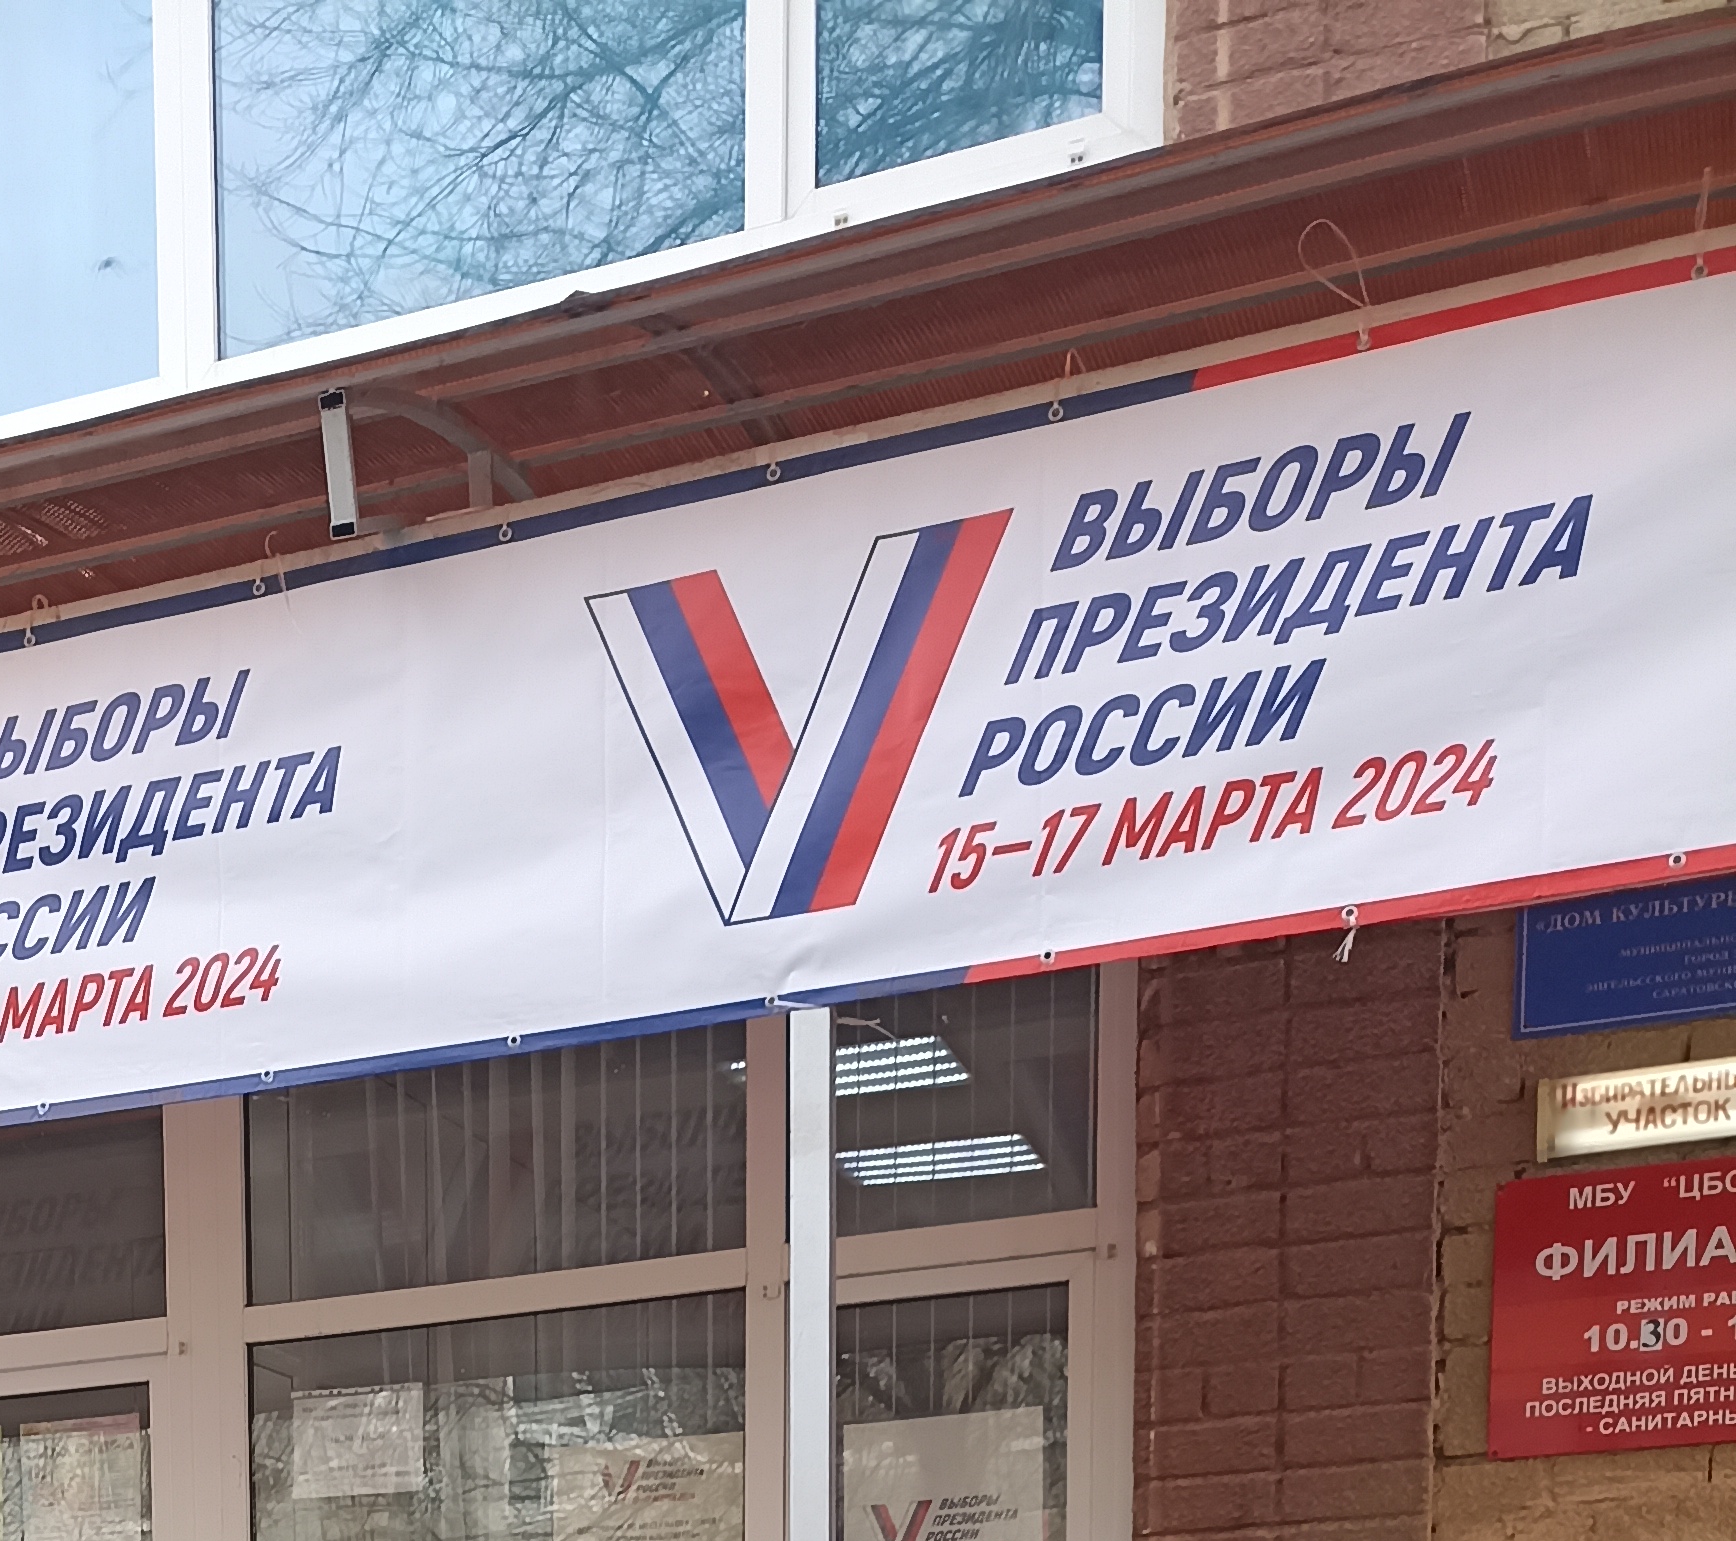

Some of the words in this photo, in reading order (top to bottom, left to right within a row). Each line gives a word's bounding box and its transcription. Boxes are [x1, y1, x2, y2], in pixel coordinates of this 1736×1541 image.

[1050, 412, 1472, 573] ВЫБОРЫ
[1004, 494, 1595, 686] ПРЕЗИДЕНТА
[958, 659, 1327, 798] РОССИИ
[1112, 767, 1324, 869] МАРТА
[1331, 739, 1497, 830] 2024
[1536, 909, 1601, 933] «ДОМ
[163, 944, 280, 1016] 2024
[1605, 1097, 1731, 1134] УЧАСТОК
[1569, 1181, 1635, 1210] МБУ
[1535, 1226, 1736, 1281] ФИЛИА
[1616, 1294, 1696, 1315] РЕЖИМ
[1584, 1318, 1688, 1352] 10.30
[1542, 1365, 1674, 1395] ВЫХОДНОЙ
[1526, 1390, 1665, 1418] ПОСЛЕДНЯЯ
[1673, 1386, 1735, 1405] ПЯТН
[932, 1508, 1019, 1527] ПРЕЗИДЕНТА
[938, 1494, 1002, 1511] ВЫБОРЫ
